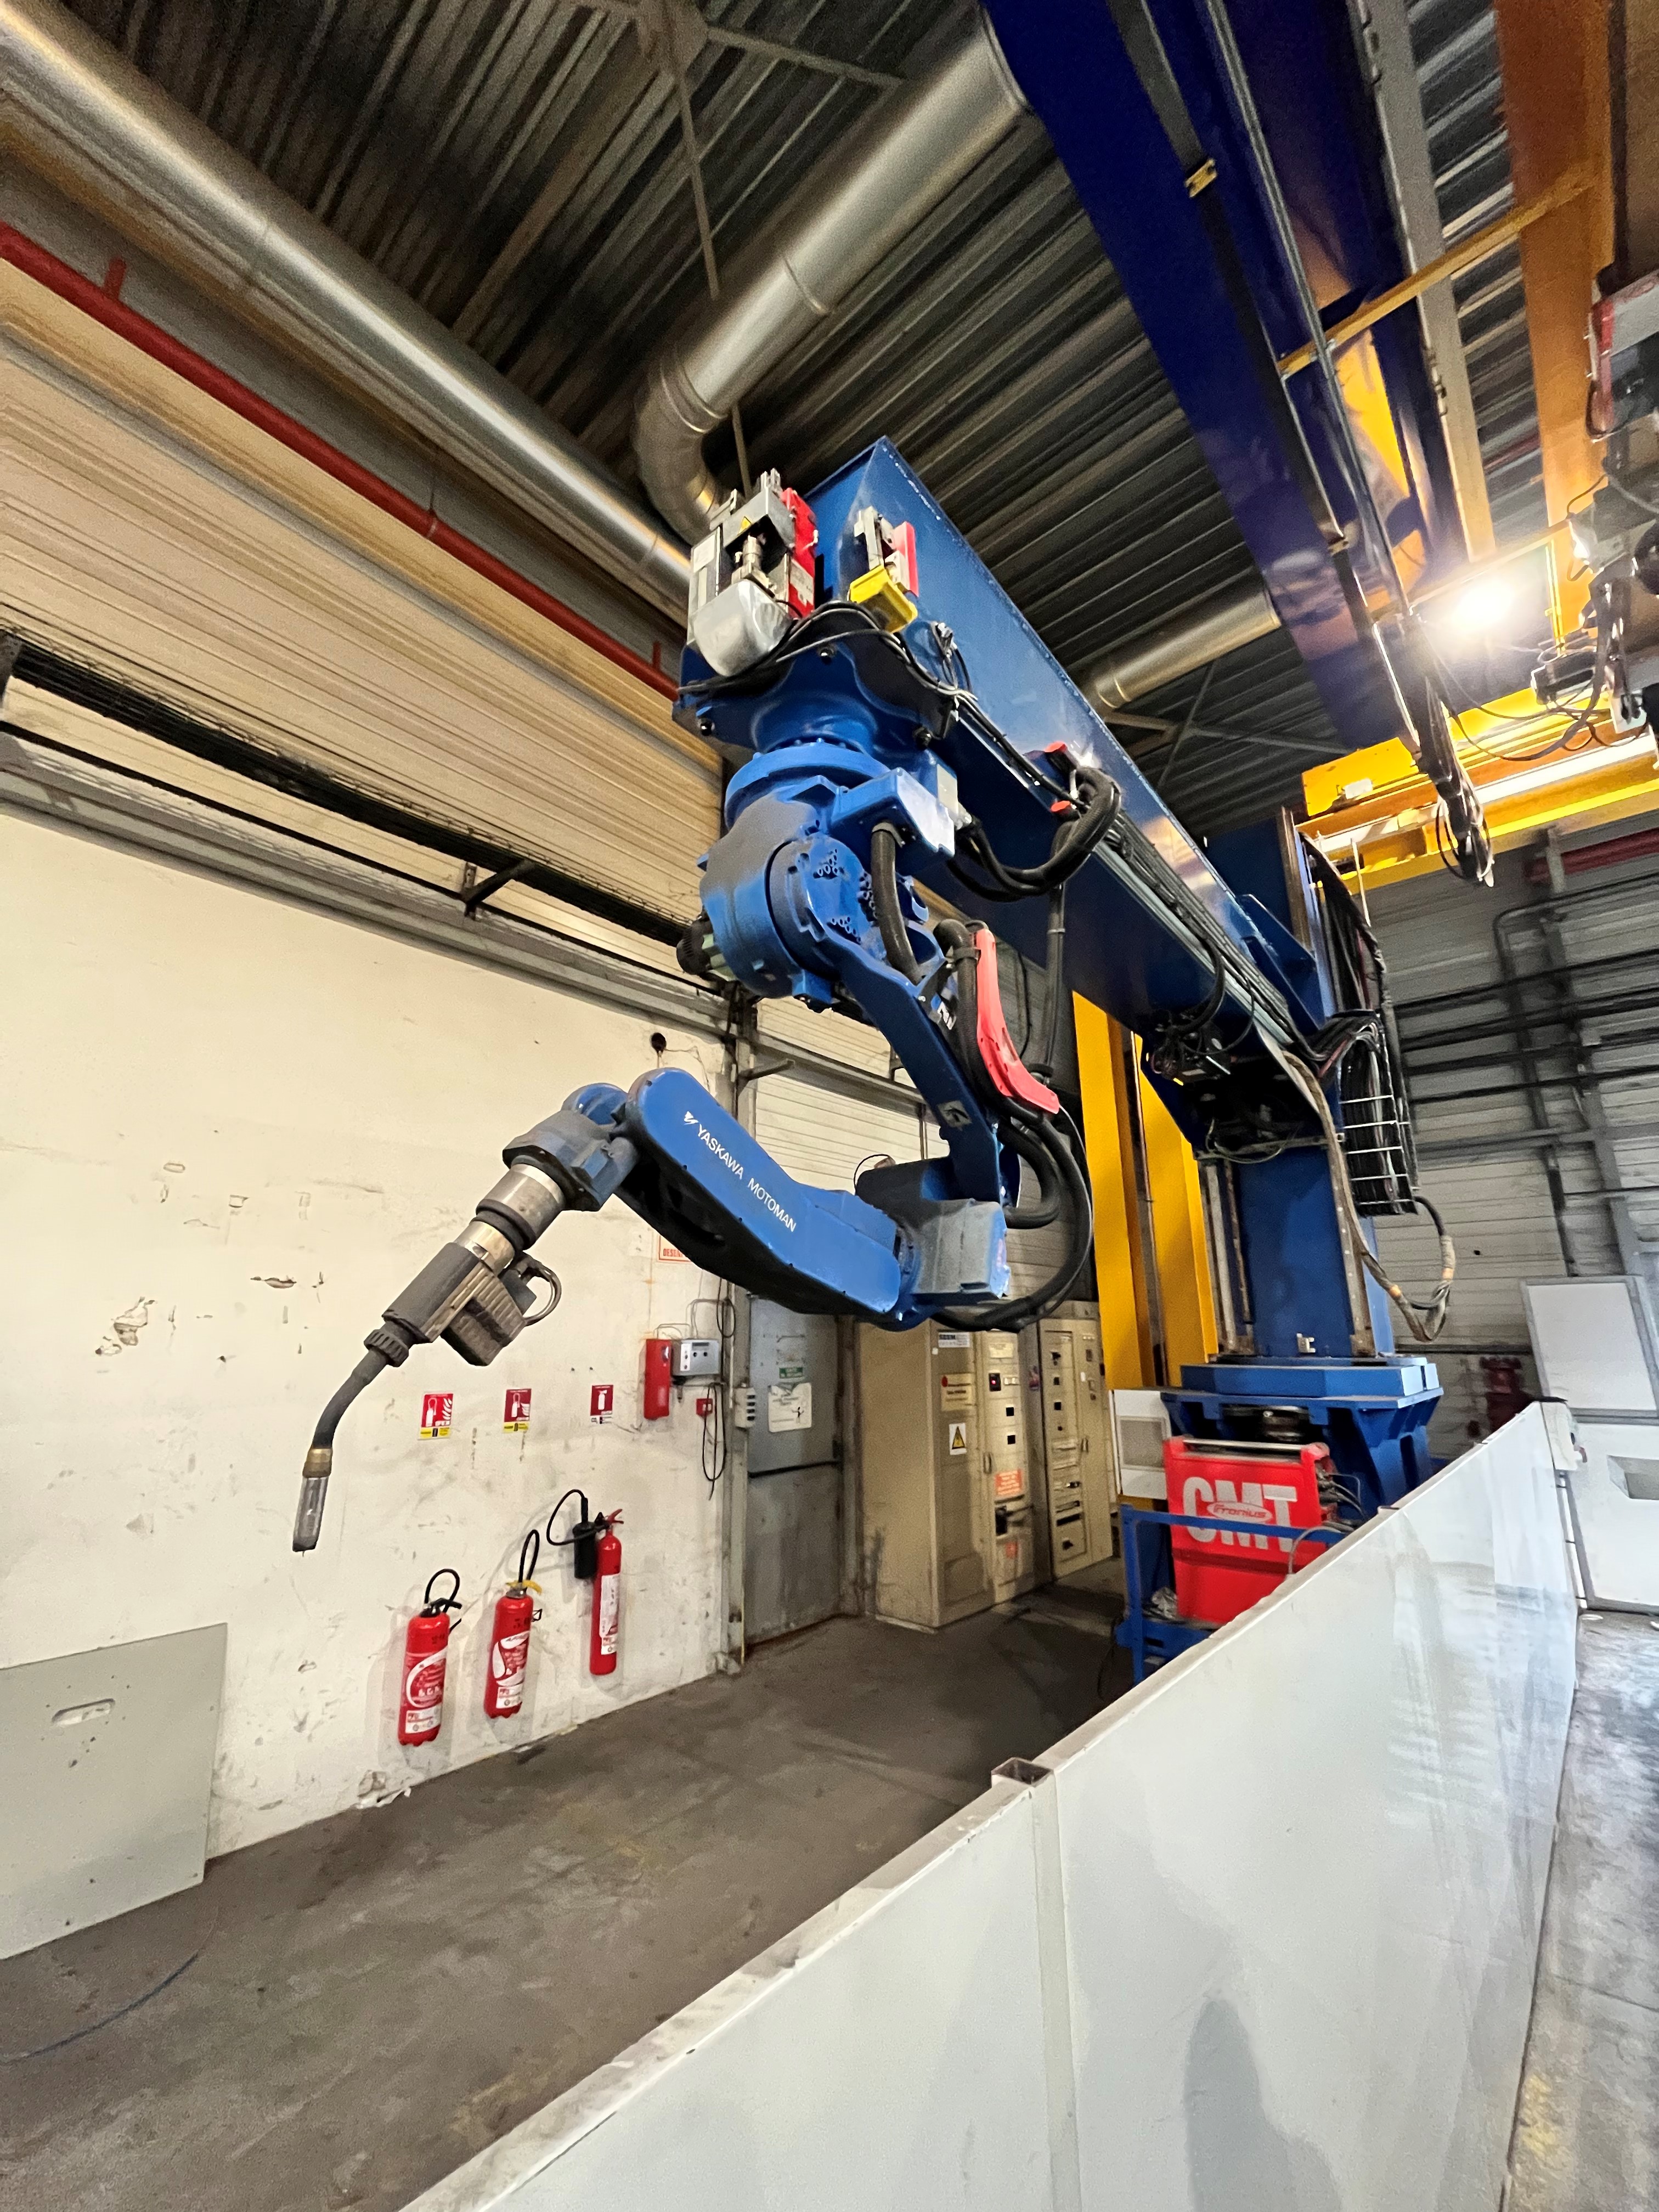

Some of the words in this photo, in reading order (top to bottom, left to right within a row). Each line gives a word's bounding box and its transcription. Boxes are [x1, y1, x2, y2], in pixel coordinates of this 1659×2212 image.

[697, 1124, 744, 1180] YASKAWA
[747, 1177, 797, 1232] MOTOMAN
[1183, 1476, 1297, 1553] CMT
[1213, 1504, 1267, 1519] Fronius
